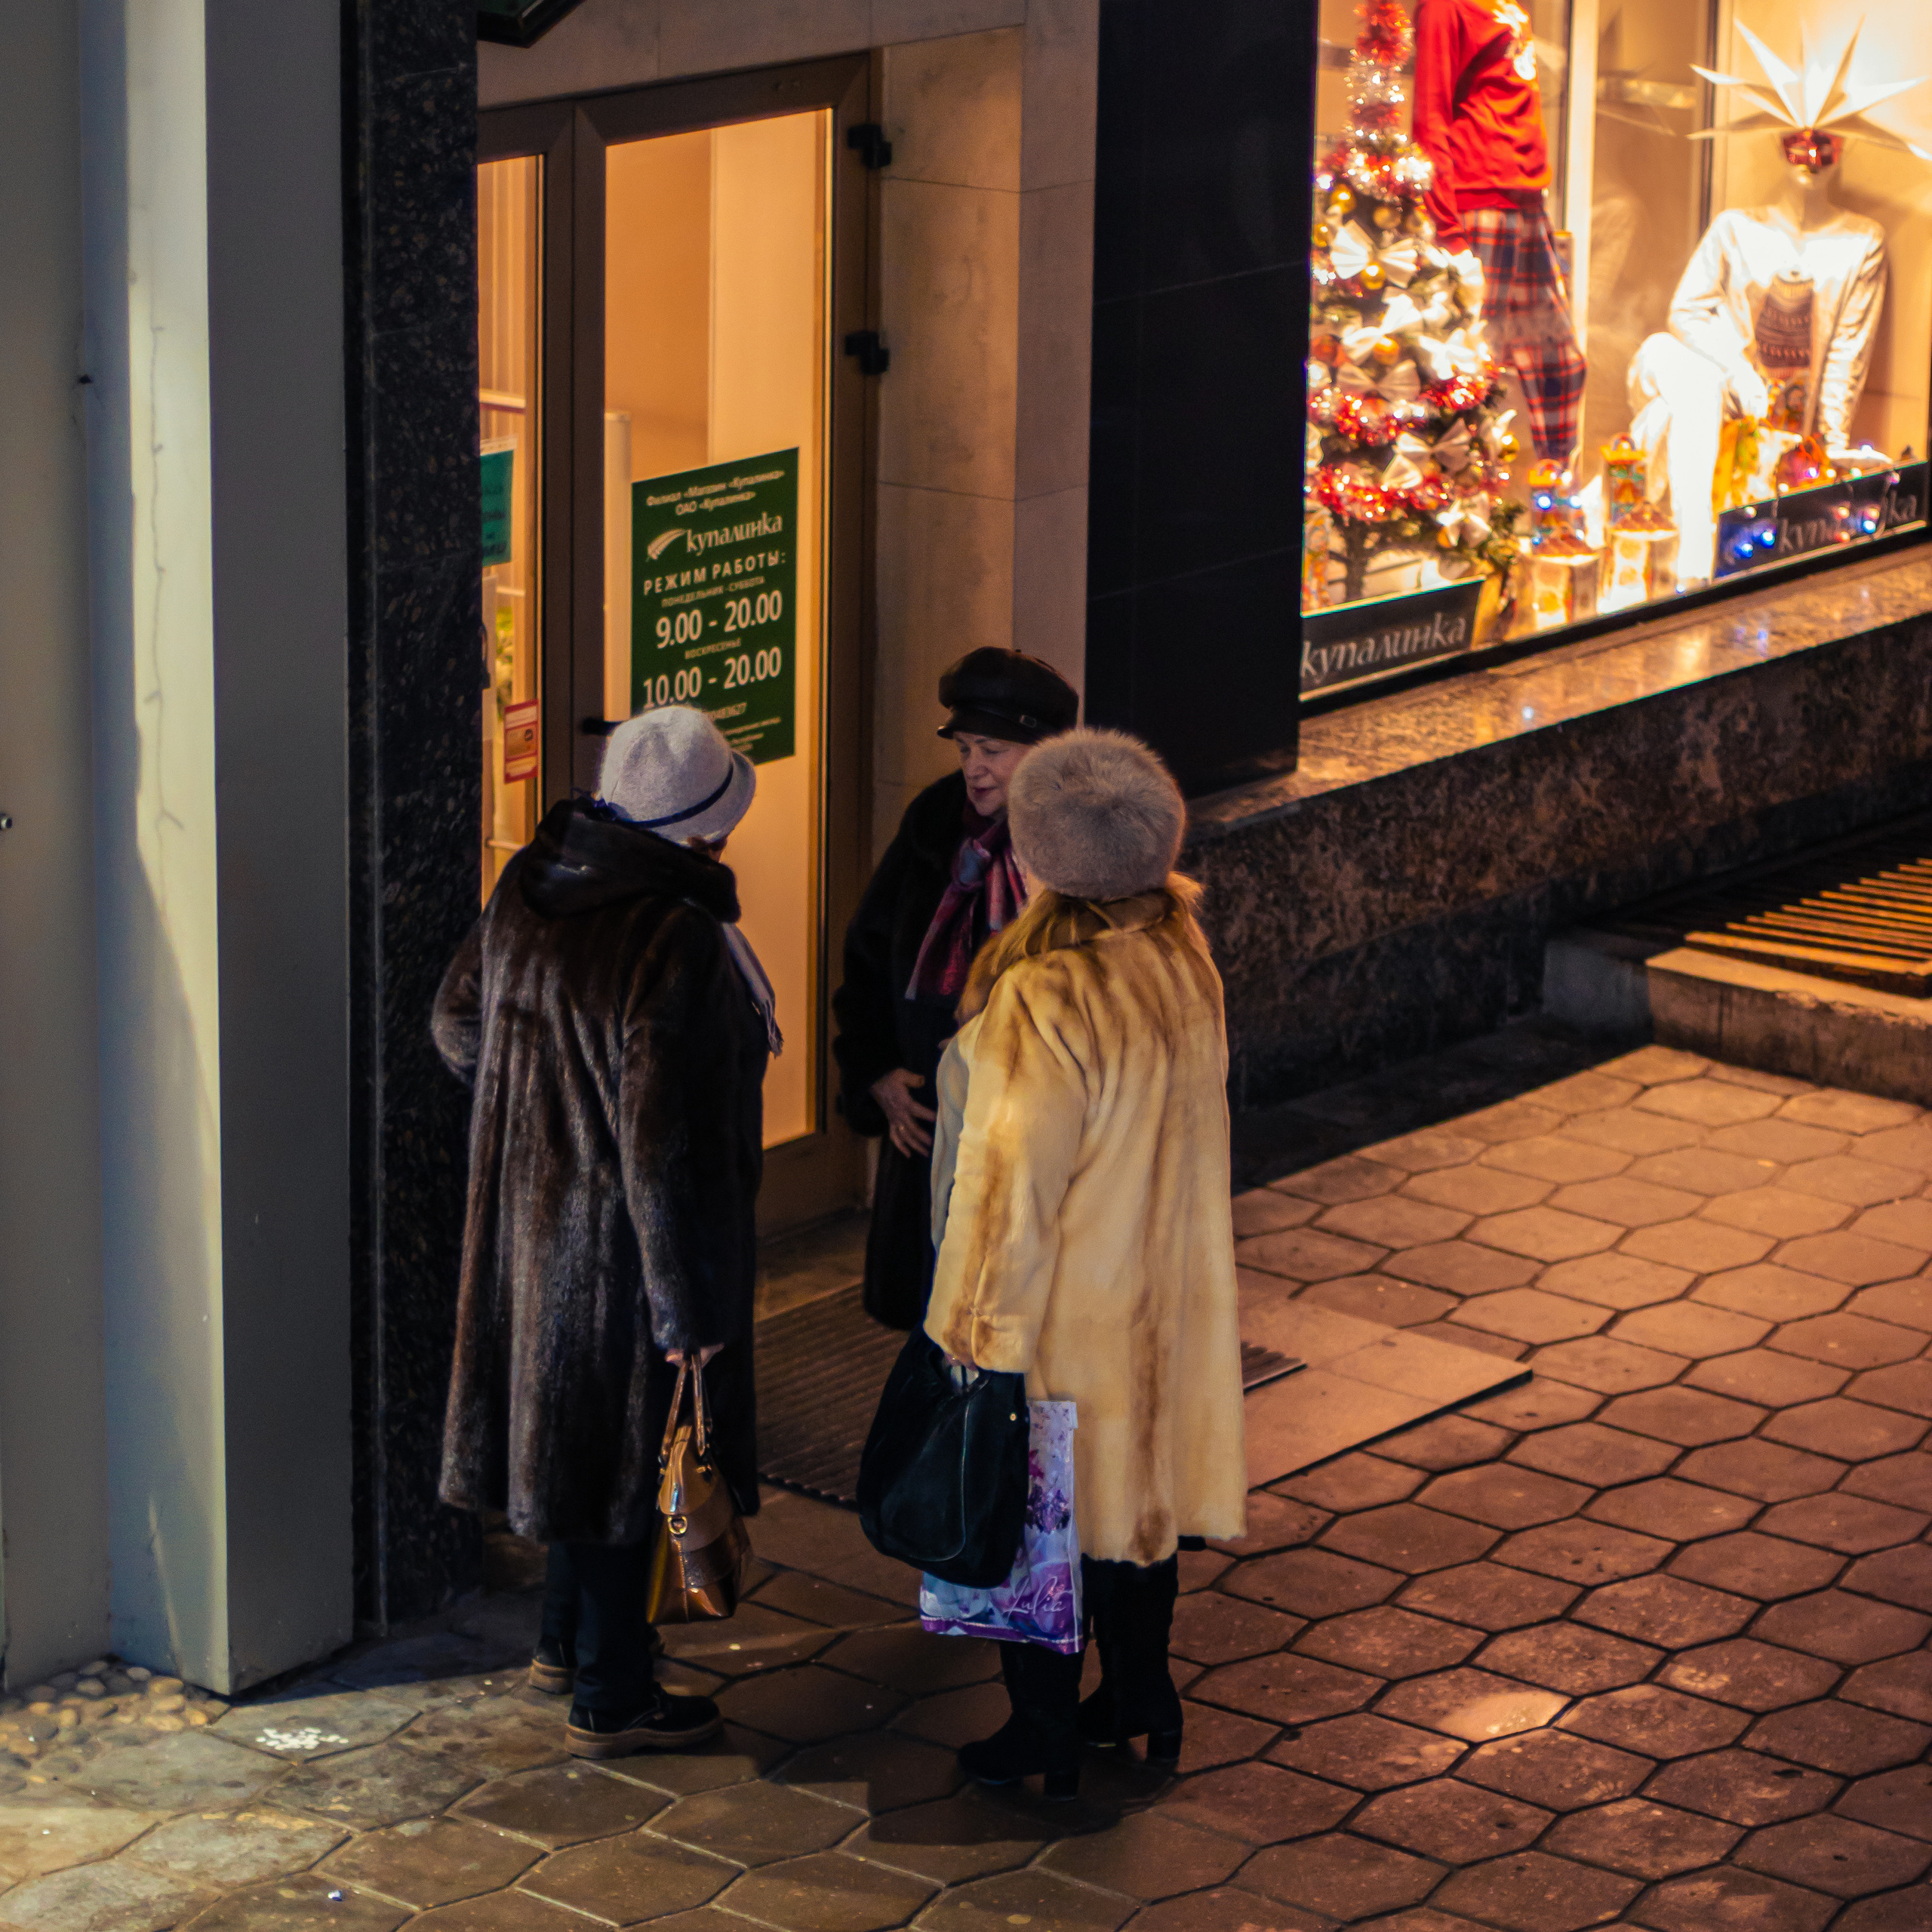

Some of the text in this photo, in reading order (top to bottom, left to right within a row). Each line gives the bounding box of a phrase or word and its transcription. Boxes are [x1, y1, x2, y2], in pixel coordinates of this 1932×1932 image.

[687, 512, 783, 556] купалинка
[644, 550, 786, 595] РЕЖИМ РАБОТЫ:
[656, 610, 703, 649] 9.00
[724, 590, 783, 632] 20.00
[1300, 612, 1466, 685] купалинка
[644, 666, 703, 709] 10.00
[724, 647, 782, 689] 20.00
